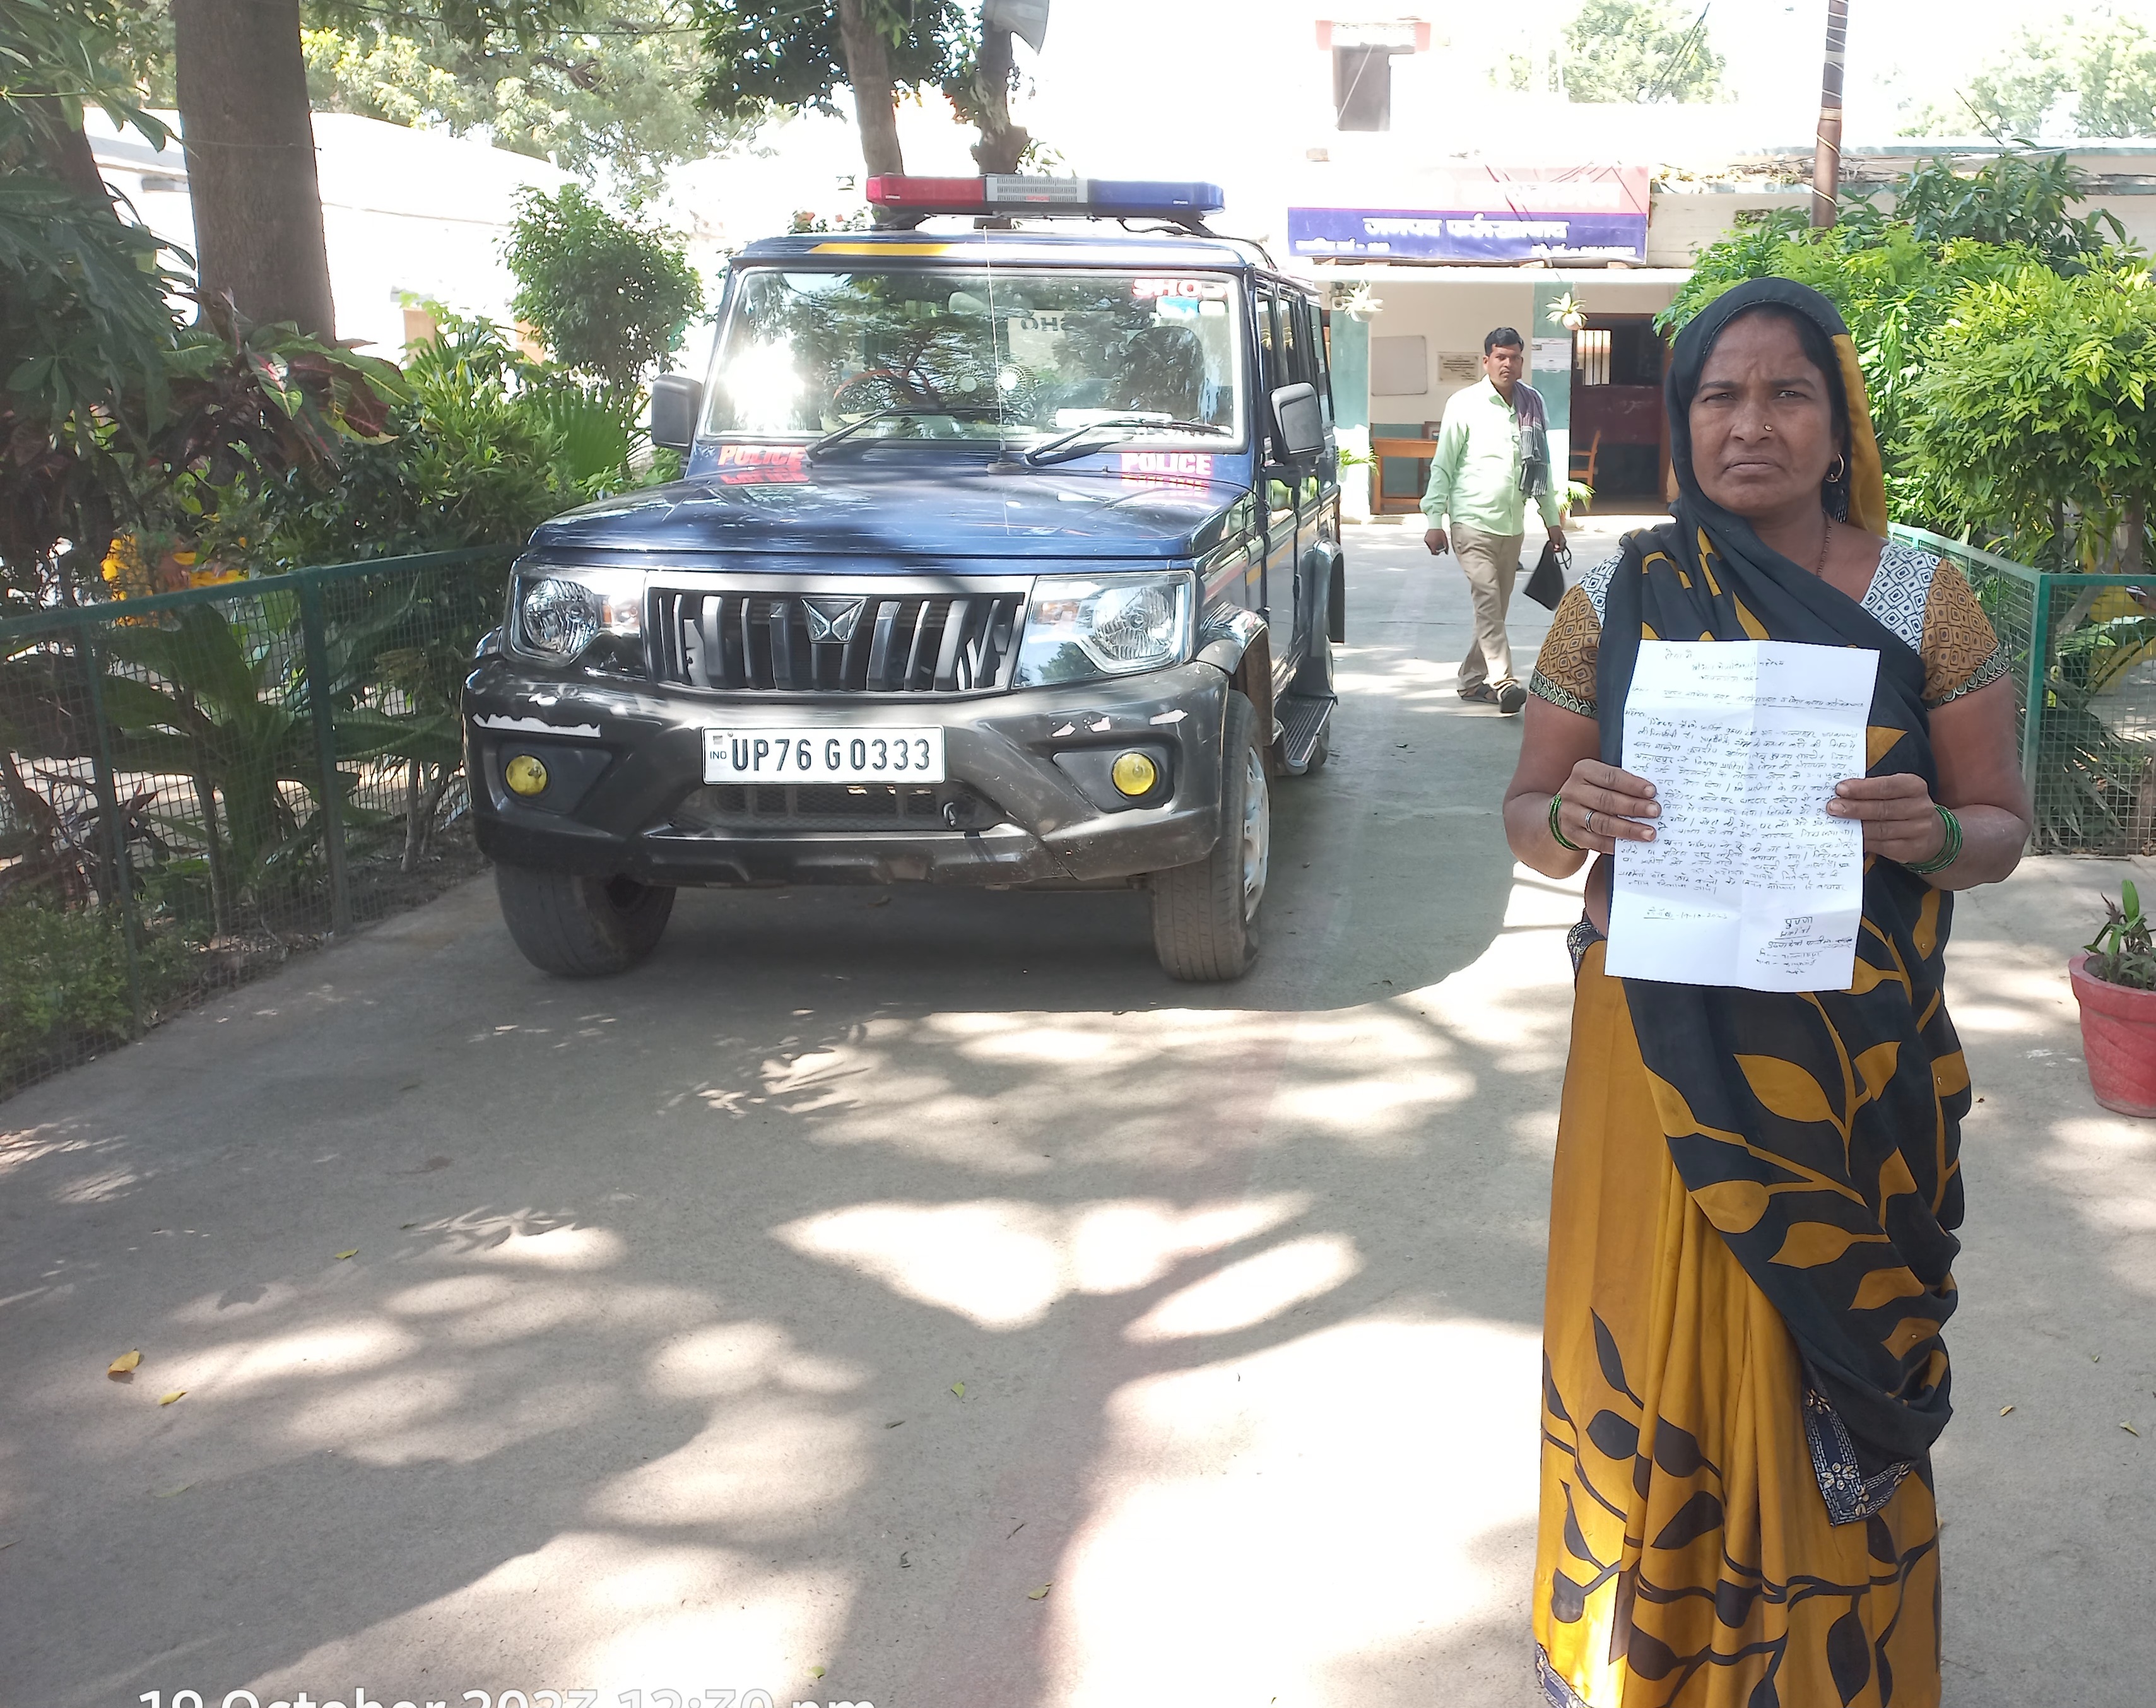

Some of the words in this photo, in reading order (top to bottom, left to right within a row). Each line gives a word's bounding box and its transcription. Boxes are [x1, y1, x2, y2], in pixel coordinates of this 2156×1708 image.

[1133, 278, 1201, 297] SHO
[718, 445, 806, 466] POLICE
[1121, 452, 1211, 475] POLICE
[710, 751, 726, 760] IND
